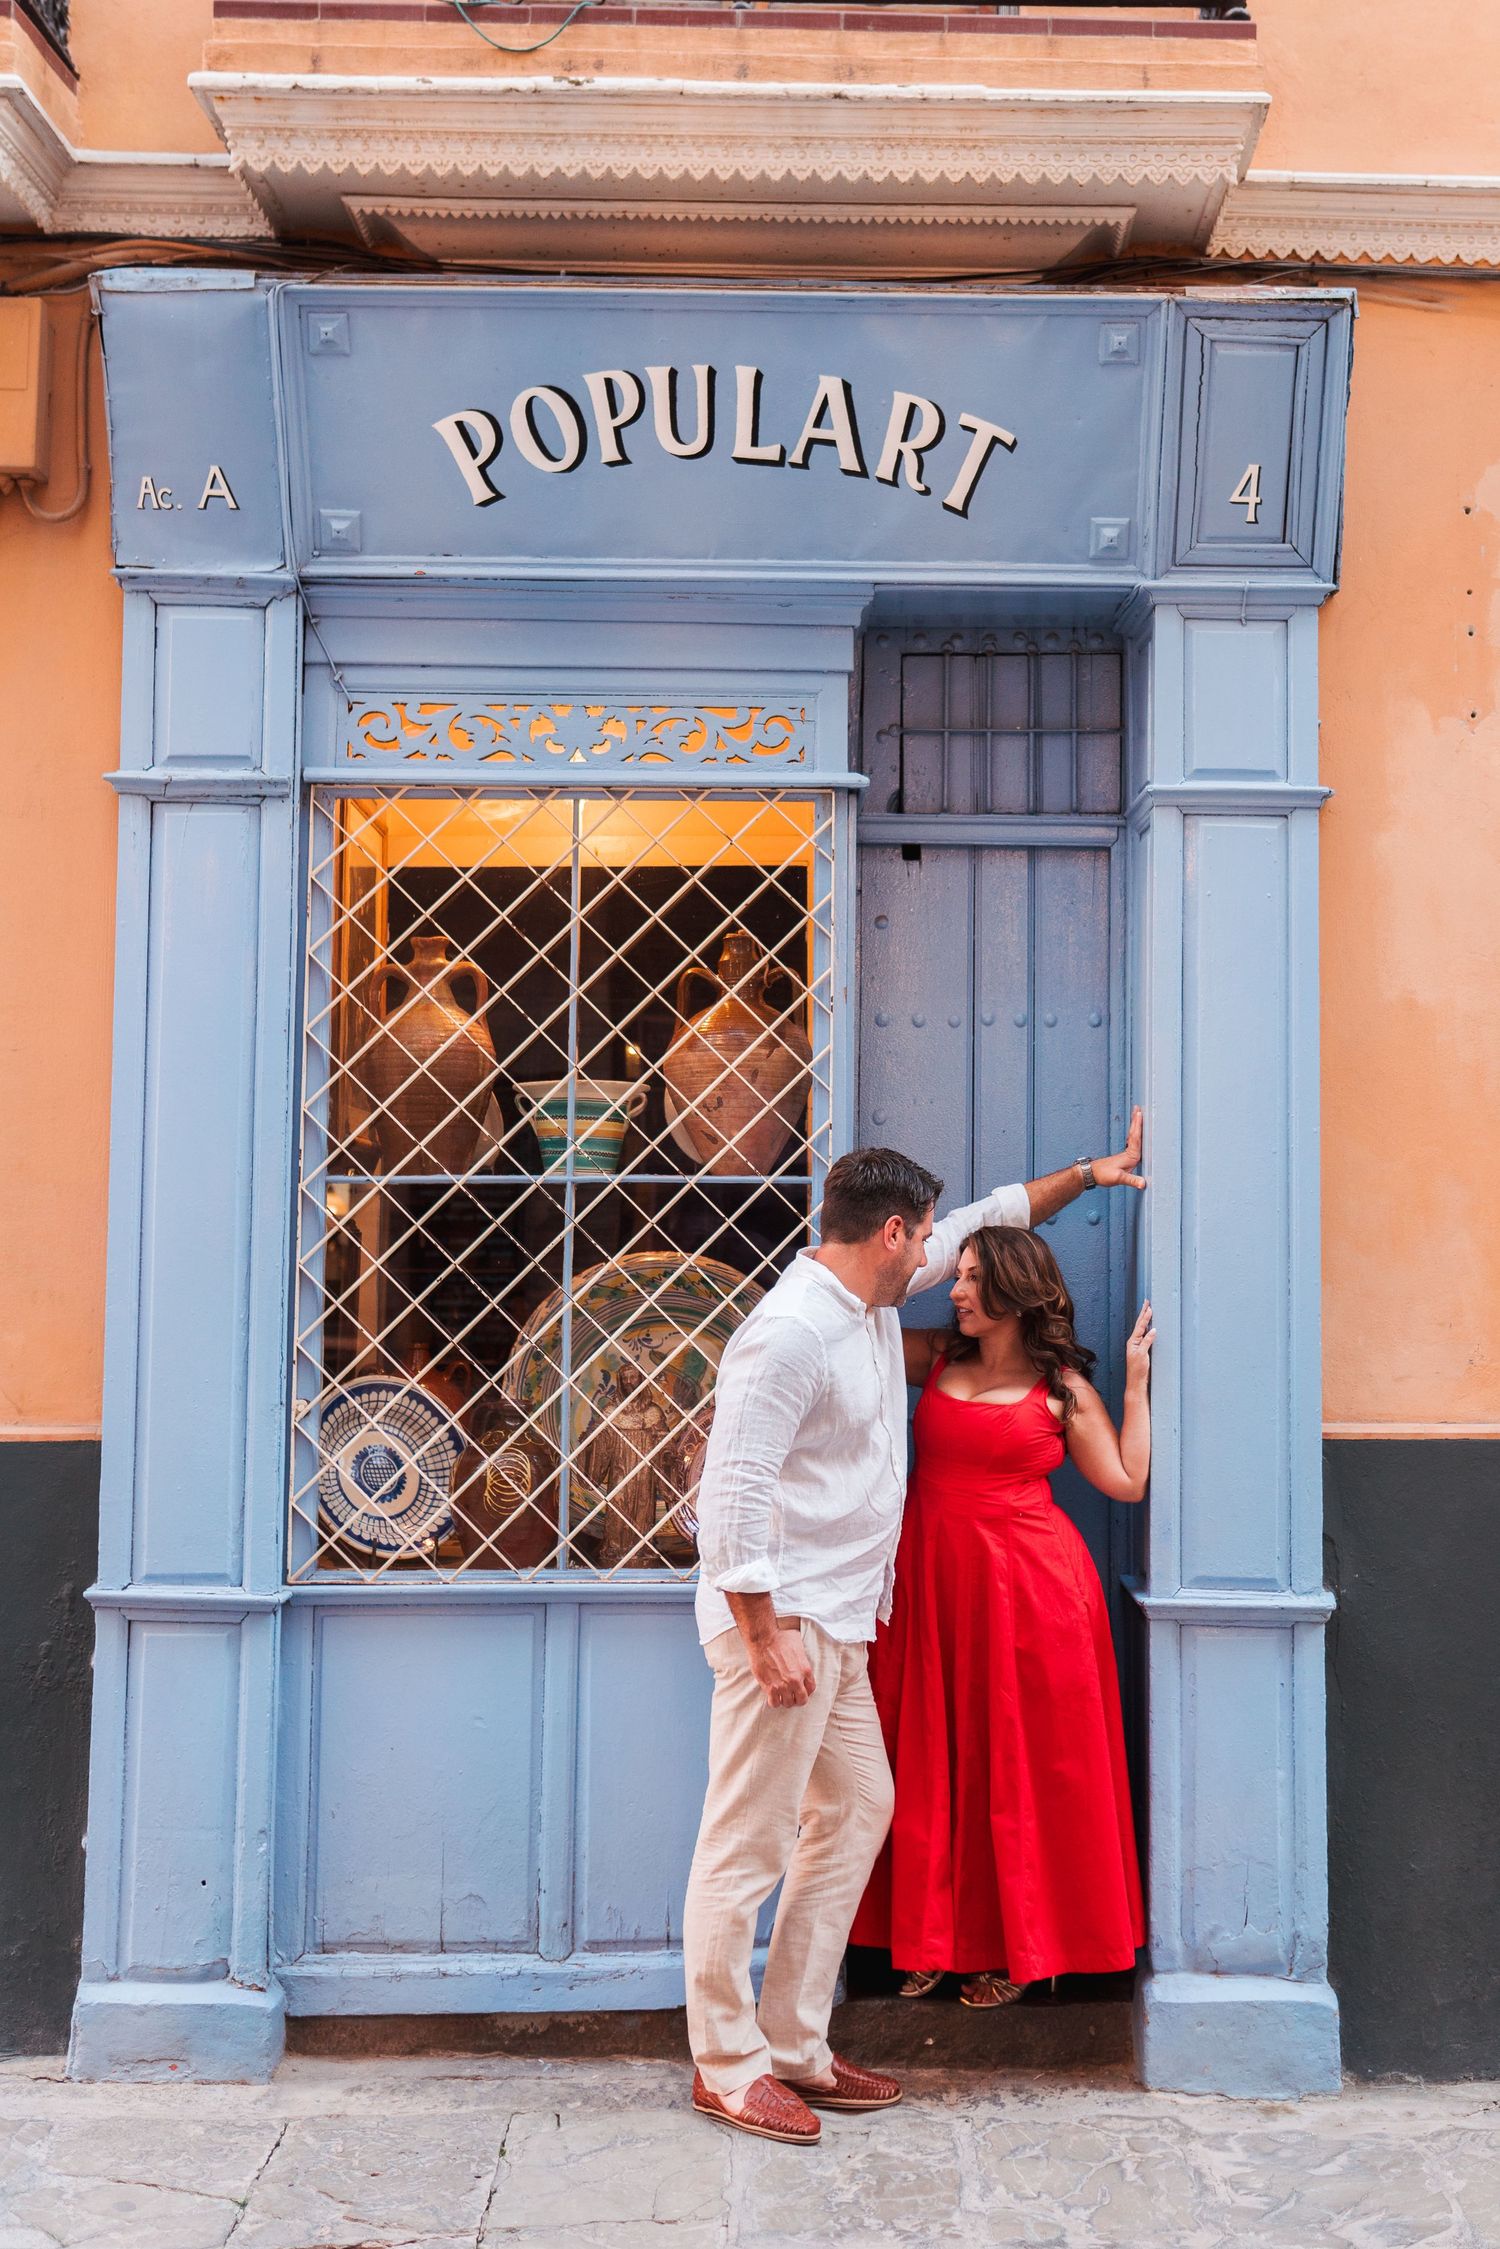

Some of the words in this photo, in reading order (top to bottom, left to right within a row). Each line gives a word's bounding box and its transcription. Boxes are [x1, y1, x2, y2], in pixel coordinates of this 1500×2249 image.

[432, 363, 1017, 519] POPULART
[137, 475, 183, 510] Ac.
[198, 465, 240, 510] A
[1229, 463, 1262, 524] 4
